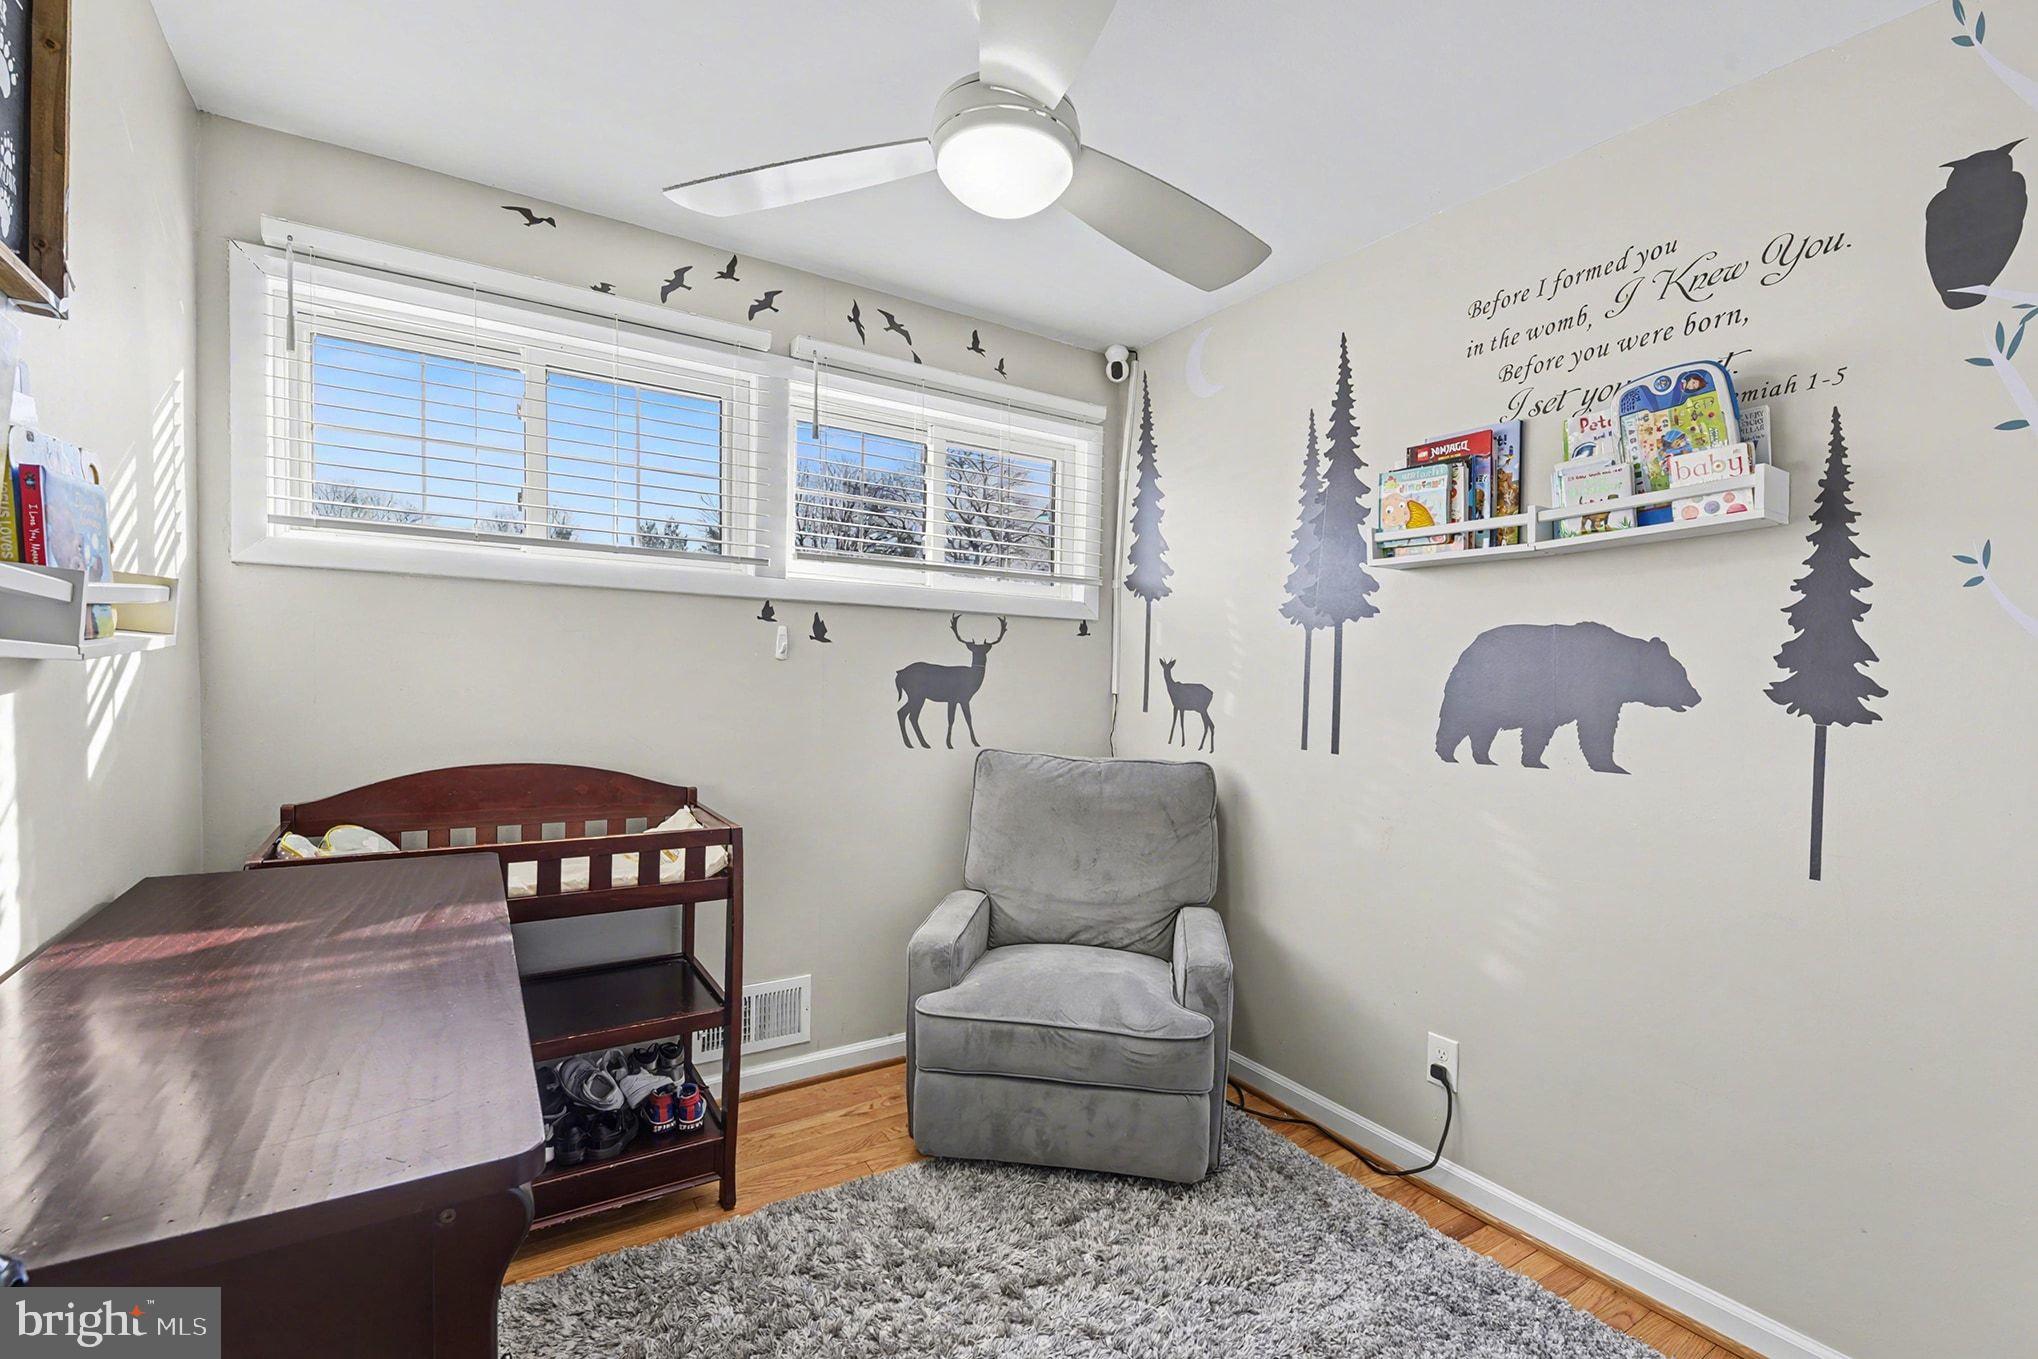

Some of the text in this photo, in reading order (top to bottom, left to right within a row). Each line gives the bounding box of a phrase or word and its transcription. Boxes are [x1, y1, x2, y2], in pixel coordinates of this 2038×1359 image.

[1466, 340, 1484, 359] in
[1490, 328, 1521, 352] the
[1525, 304, 1593, 341] womb,
[1651, 251, 1750, 303] Knew
[1760, 232, 1853, 287] You.
[1468, 239, 1678, 320] Before I formed you
[1498, 308, 1750, 385] Before you were born,
[1528, 388, 1582, 418] set
[1735, 366, 1849, 403] miah 1-5
[1429, 440, 1471, 459] NINJAGO
[1674, 453, 1744, 481] baby
